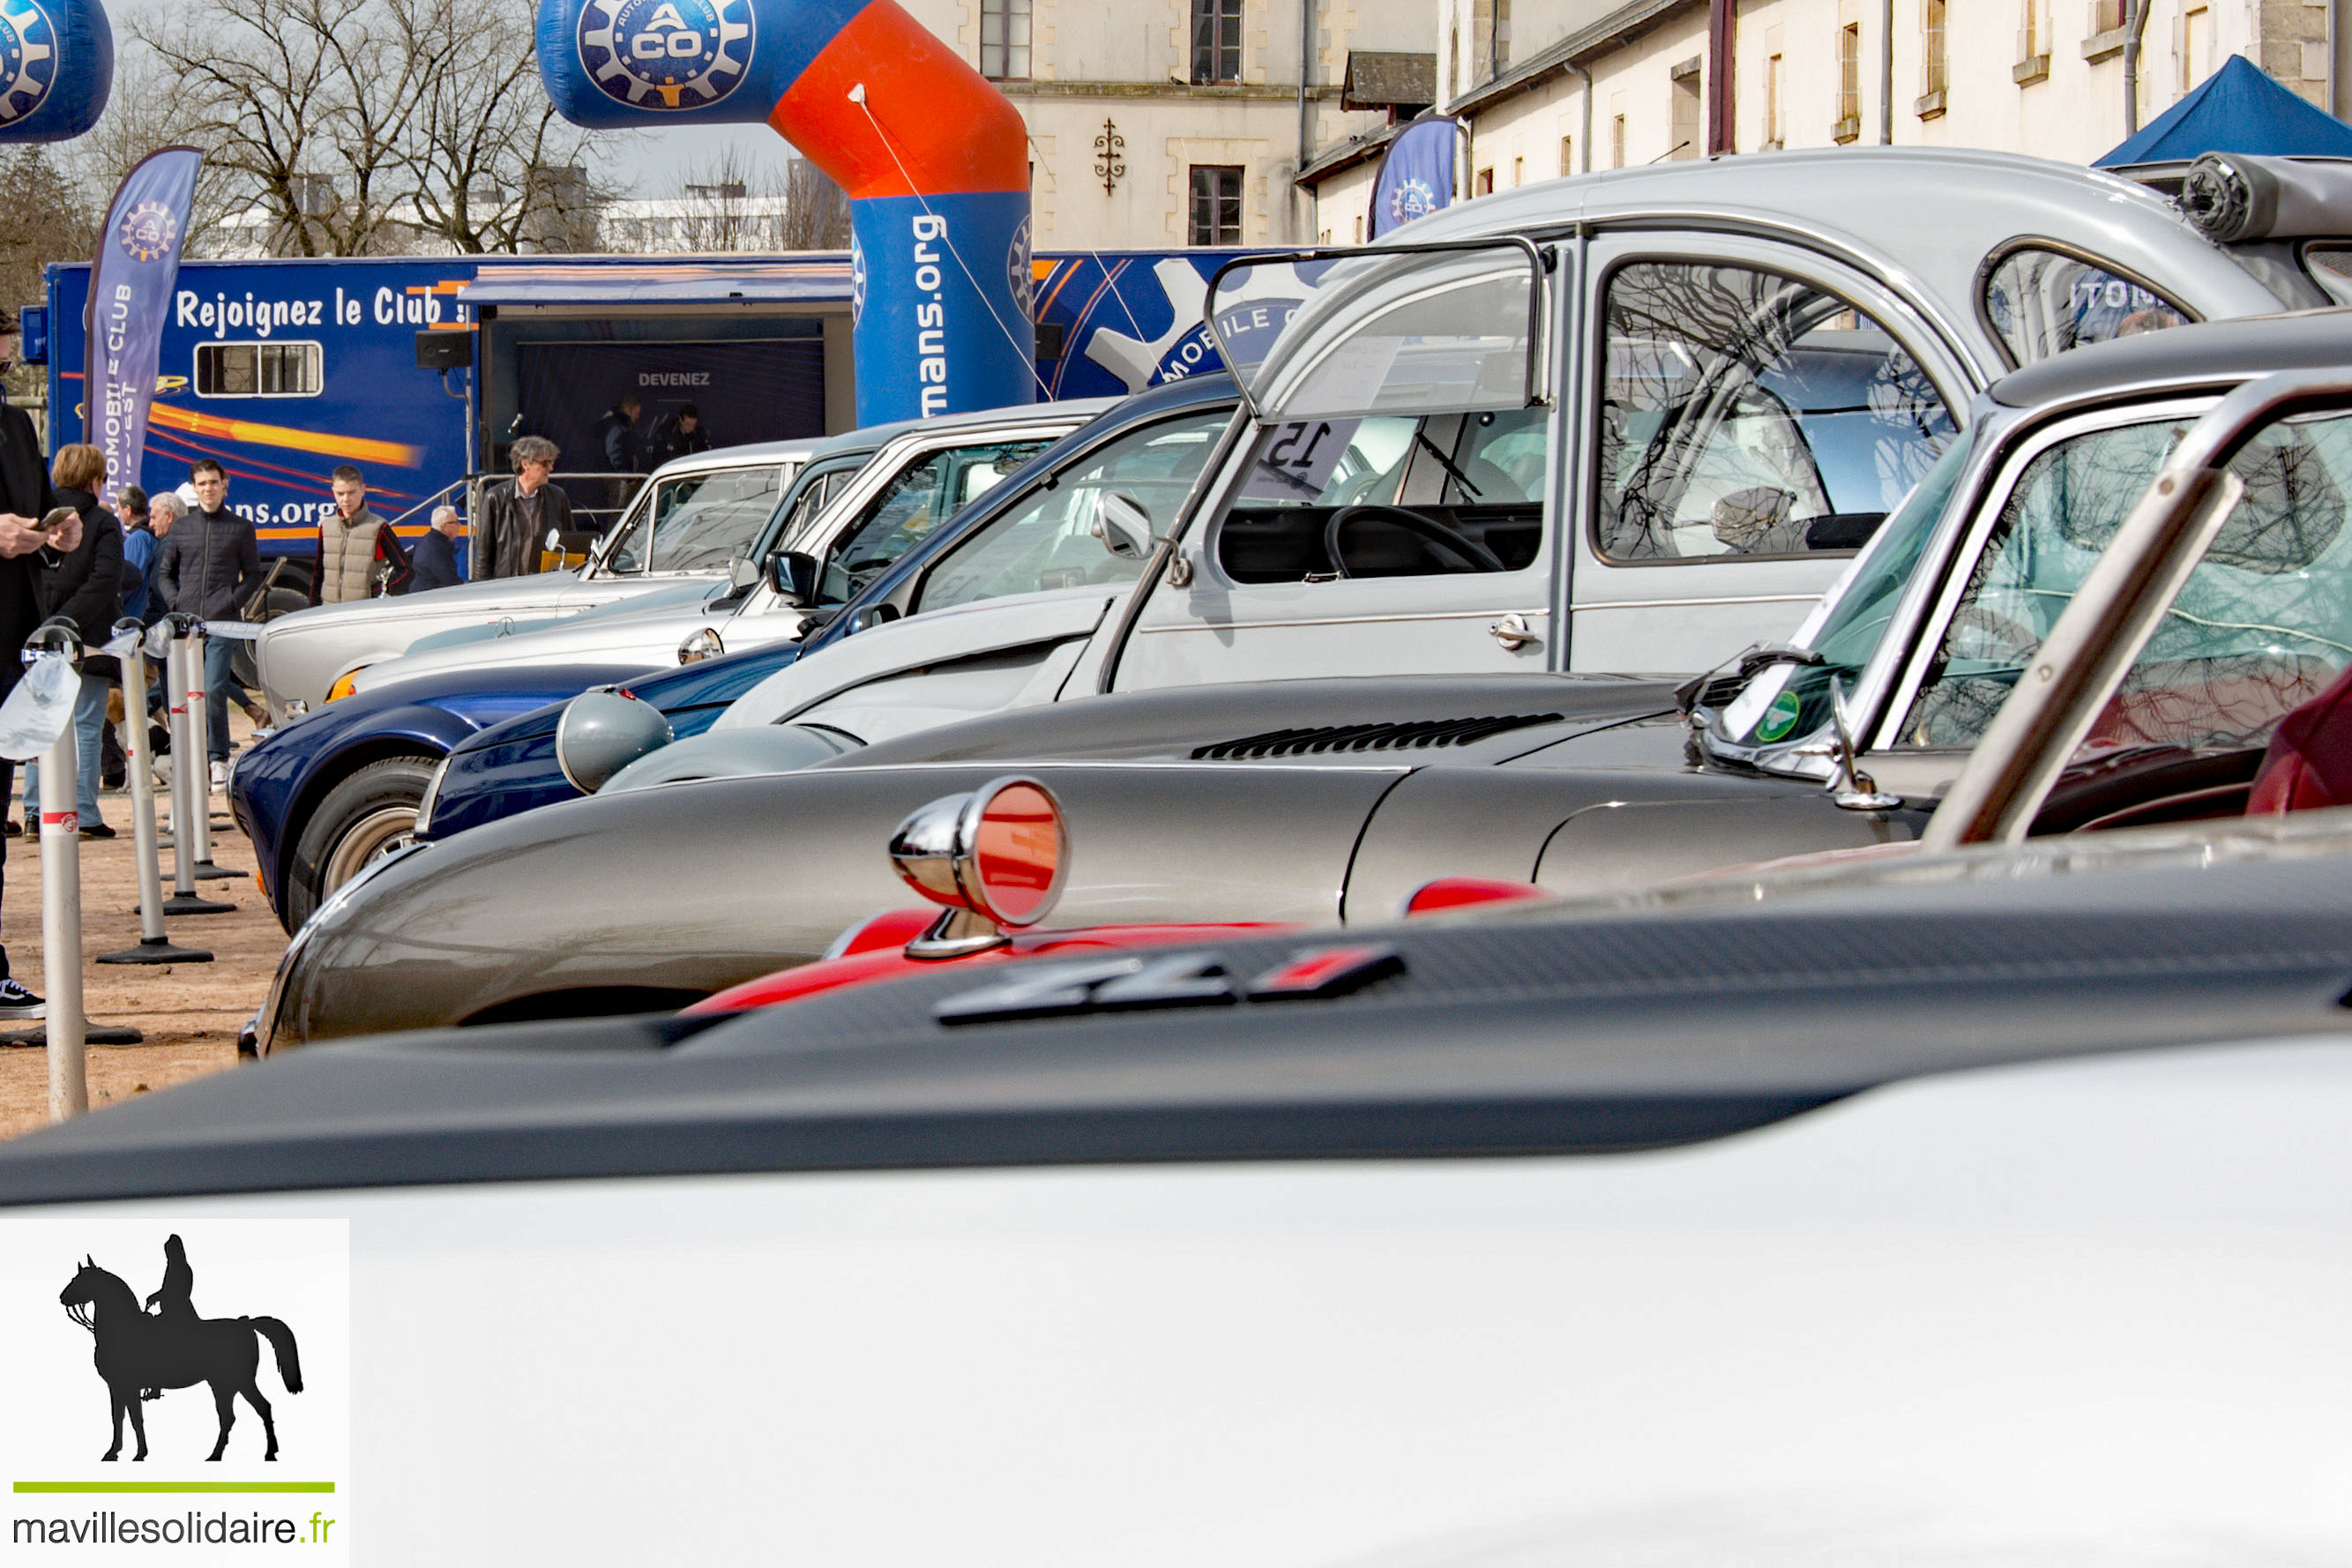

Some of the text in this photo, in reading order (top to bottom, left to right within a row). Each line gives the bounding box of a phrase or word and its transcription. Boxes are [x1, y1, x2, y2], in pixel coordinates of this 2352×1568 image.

[177, 290, 323, 339] Rejoignez
[336, 287, 362, 325] le
[375, 287, 441, 325] Club
[913, 214, 947, 419] mans.org
[105, 284, 131, 515] UTOMOBILE CLUB
[638, 372, 710, 386] DEVENEZ
[225, 503, 337, 527] ns.org
